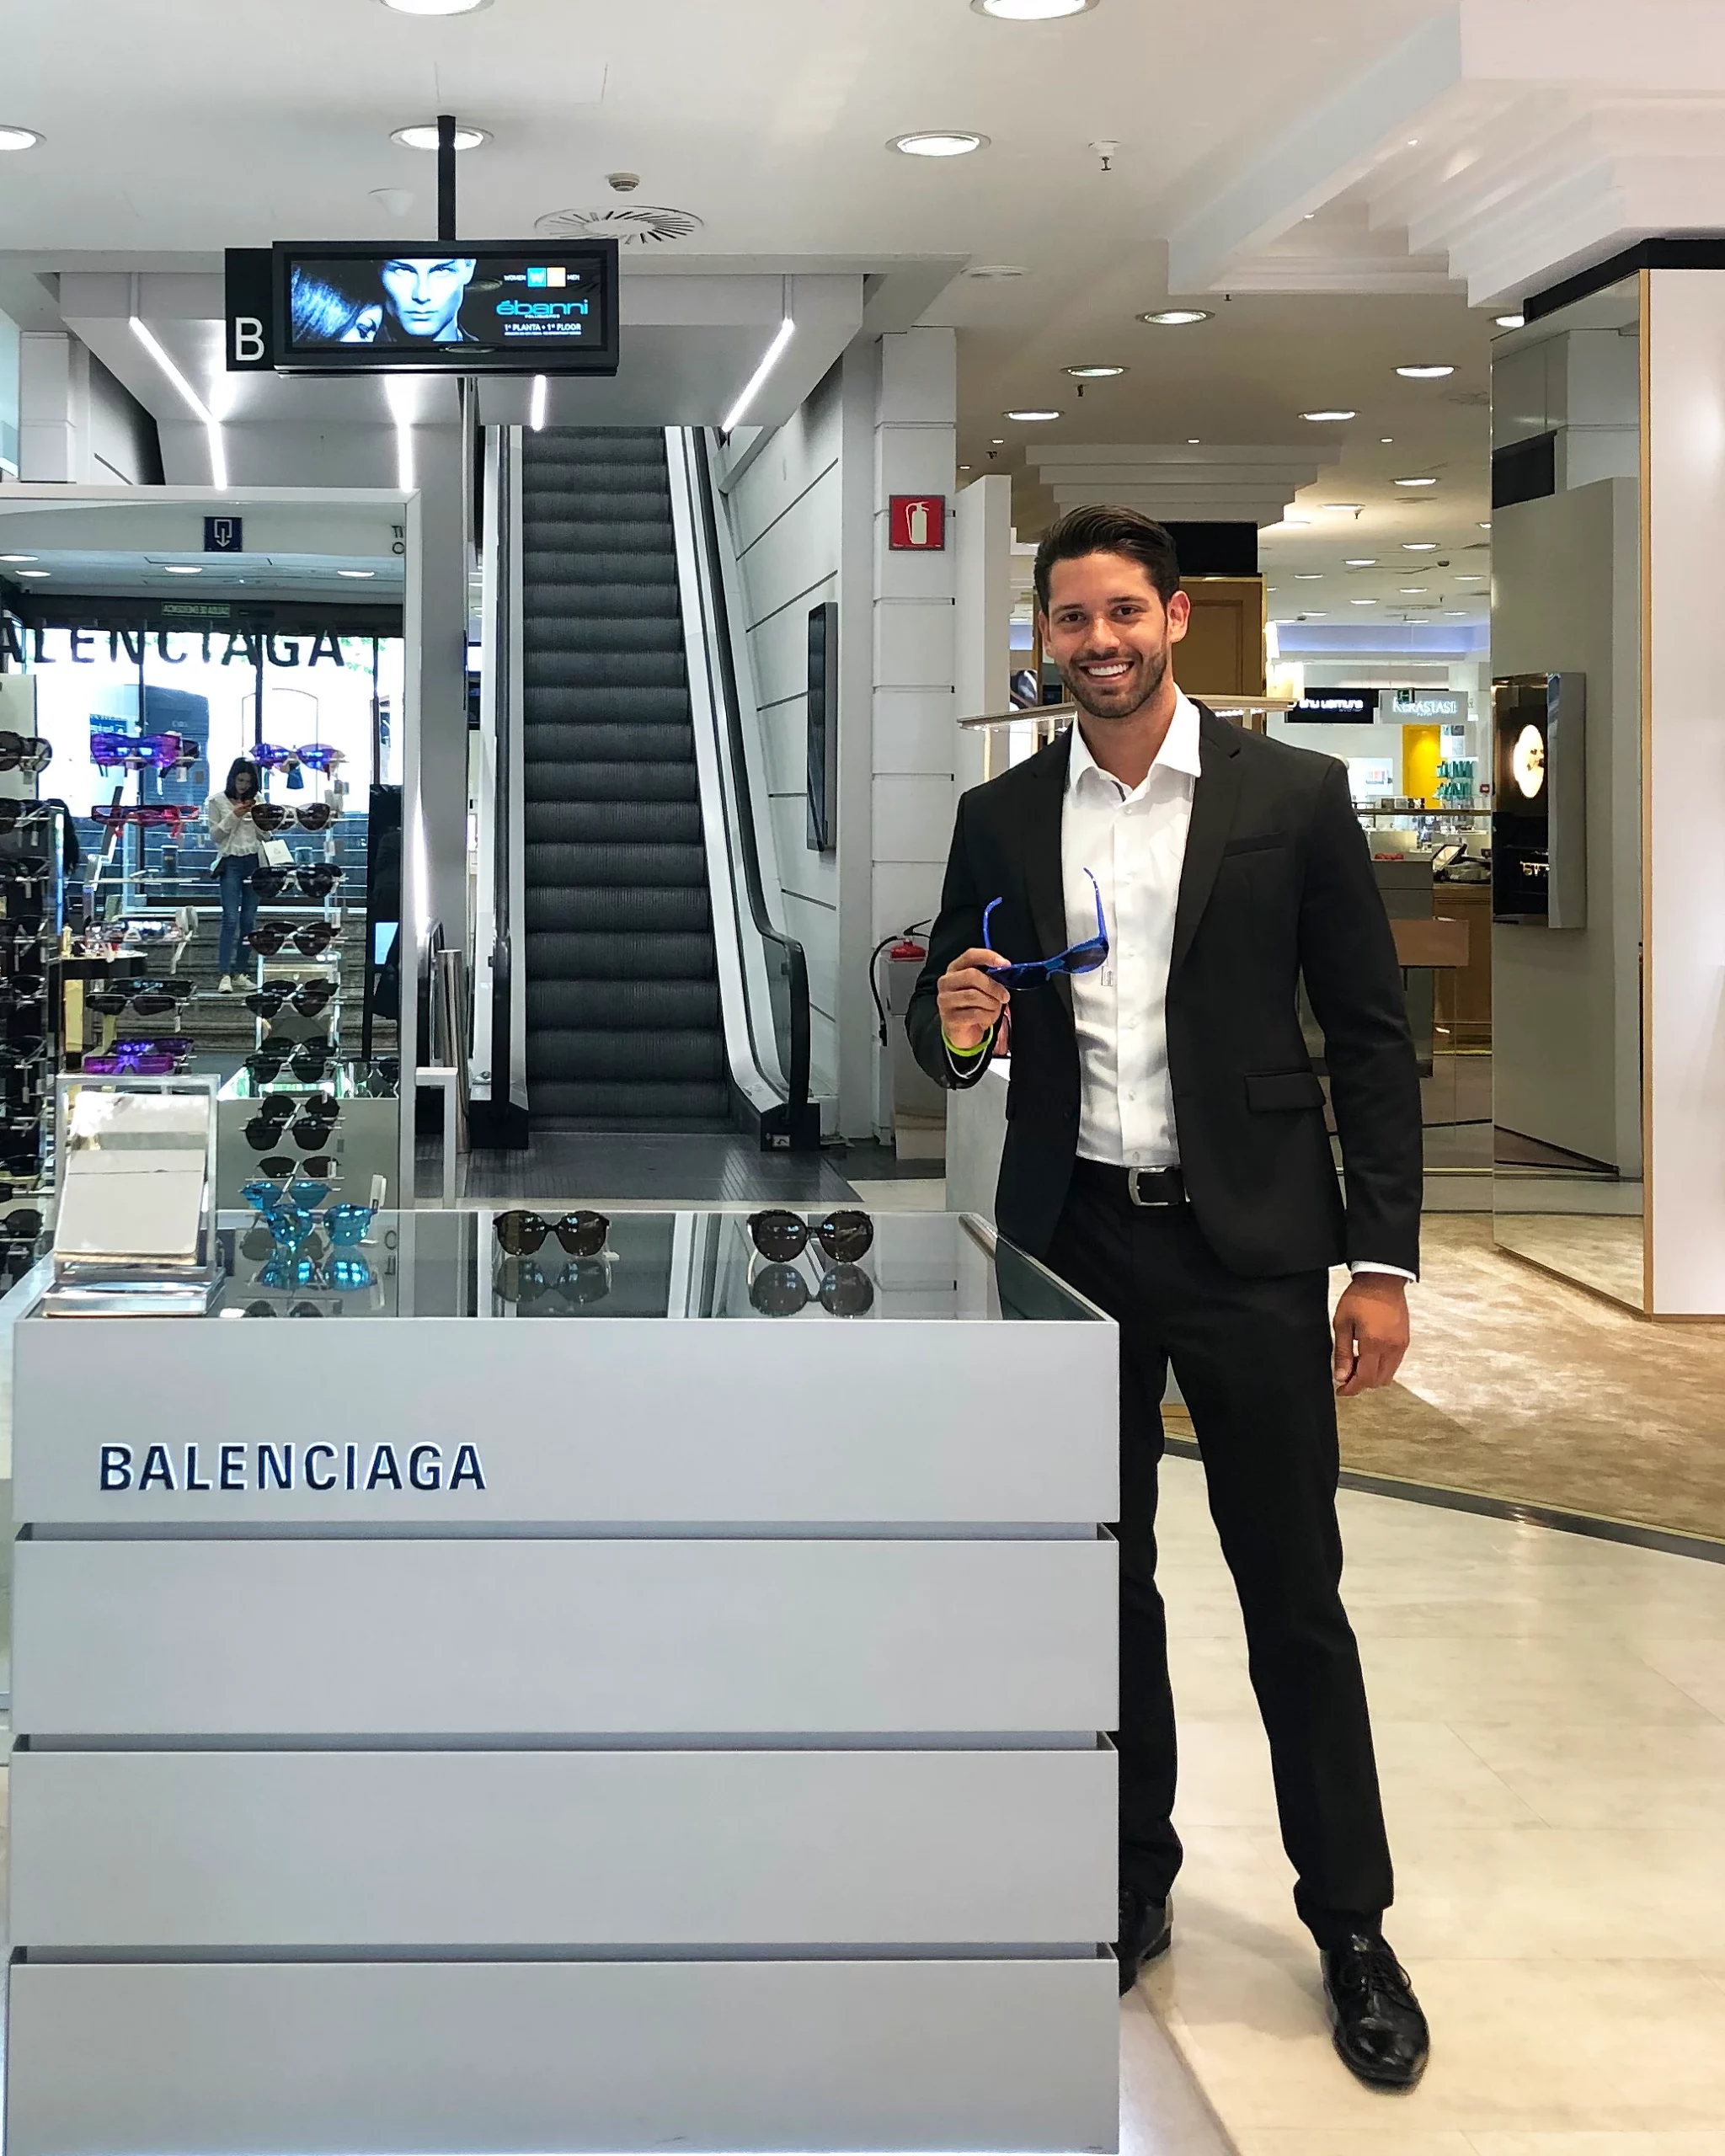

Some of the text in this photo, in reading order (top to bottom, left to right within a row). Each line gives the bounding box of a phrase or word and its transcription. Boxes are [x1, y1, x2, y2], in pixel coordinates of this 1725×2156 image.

[495, 299, 588, 316] ébanni
[236, 317, 264, 361] B
[99, 1441, 487, 1491] BALENCIAGA
